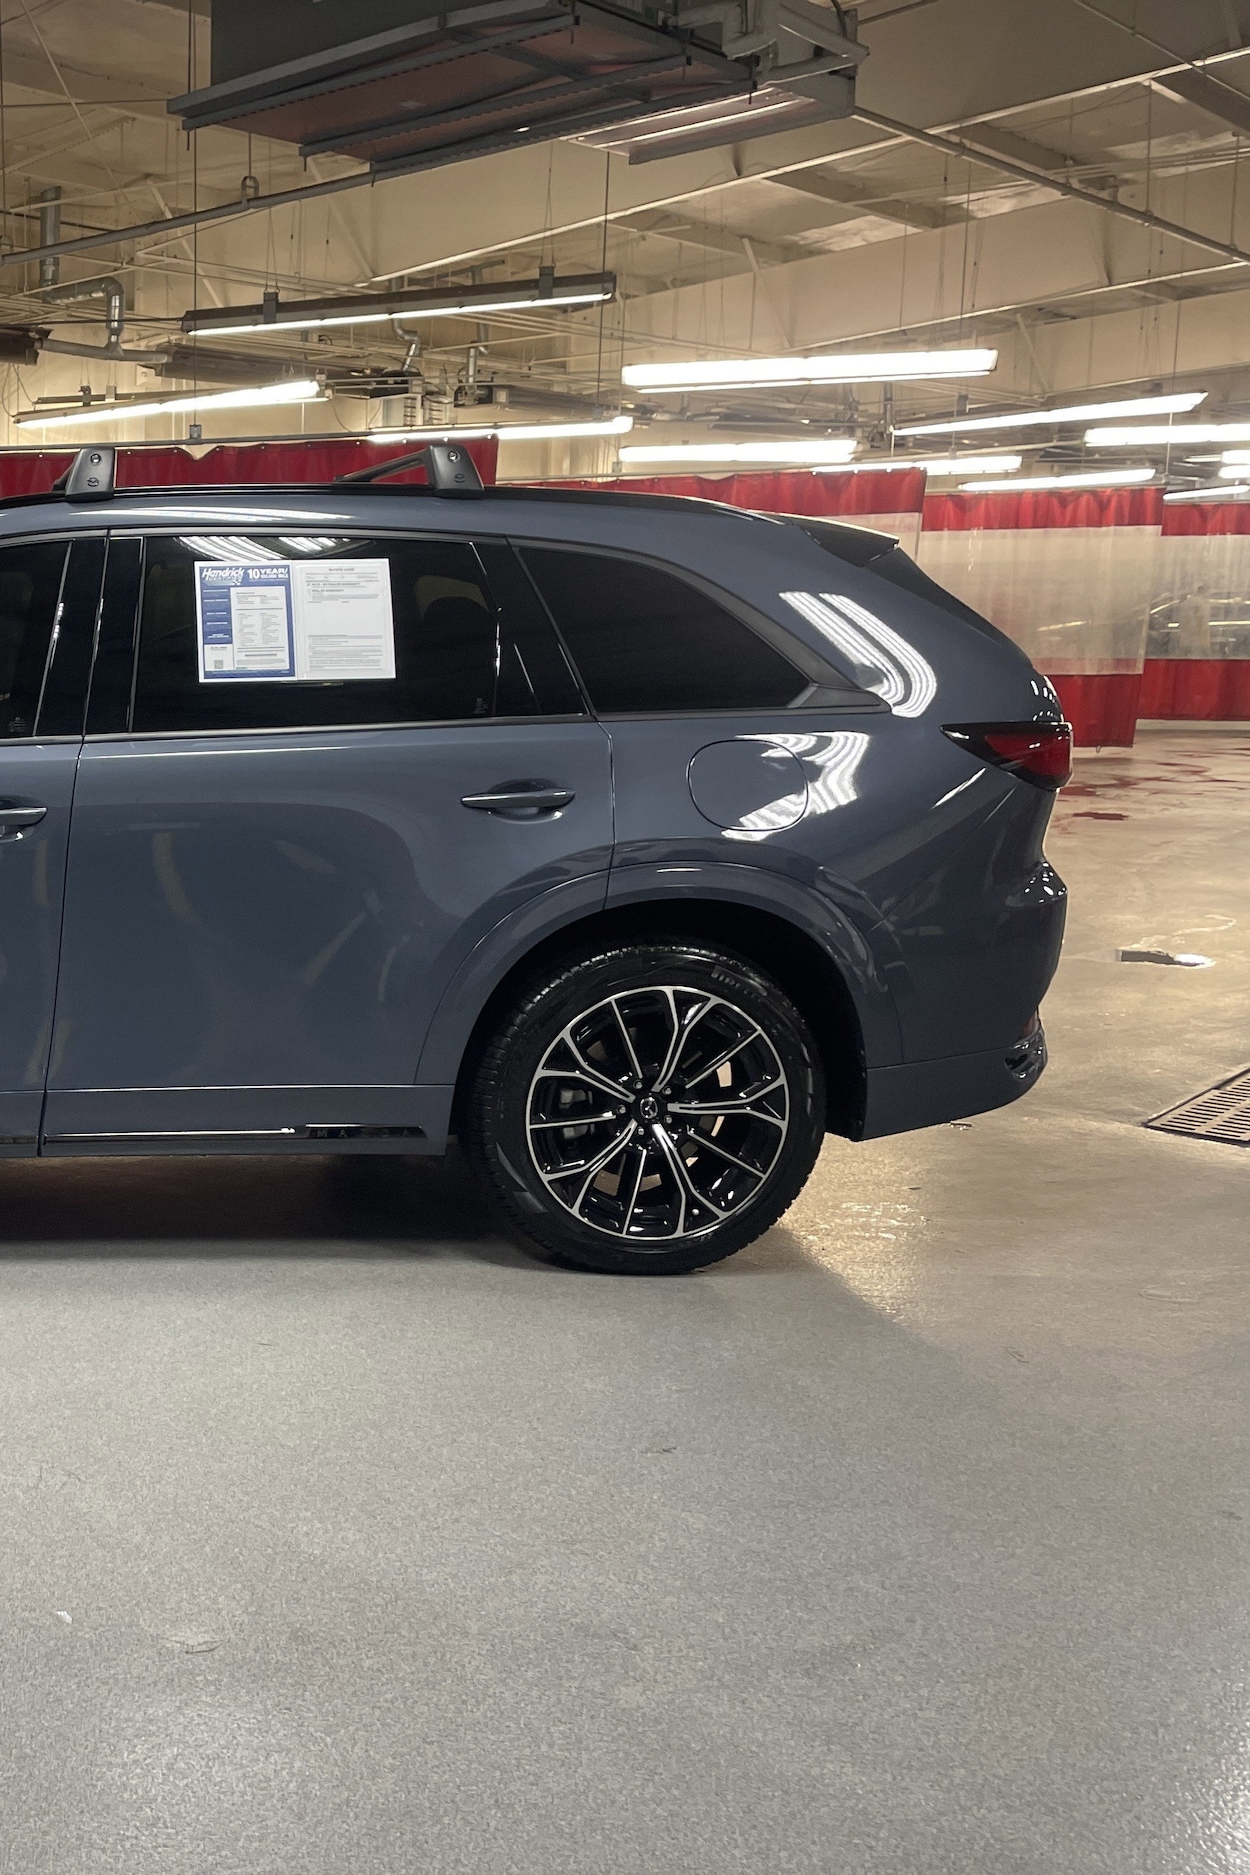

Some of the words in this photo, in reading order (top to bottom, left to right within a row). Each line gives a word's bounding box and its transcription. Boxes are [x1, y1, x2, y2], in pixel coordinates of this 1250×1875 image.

[202, 567, 245, 580] Hendrick
[247, 568, 260, 579] 10
[317, 1128, 408, 1138] MADA
